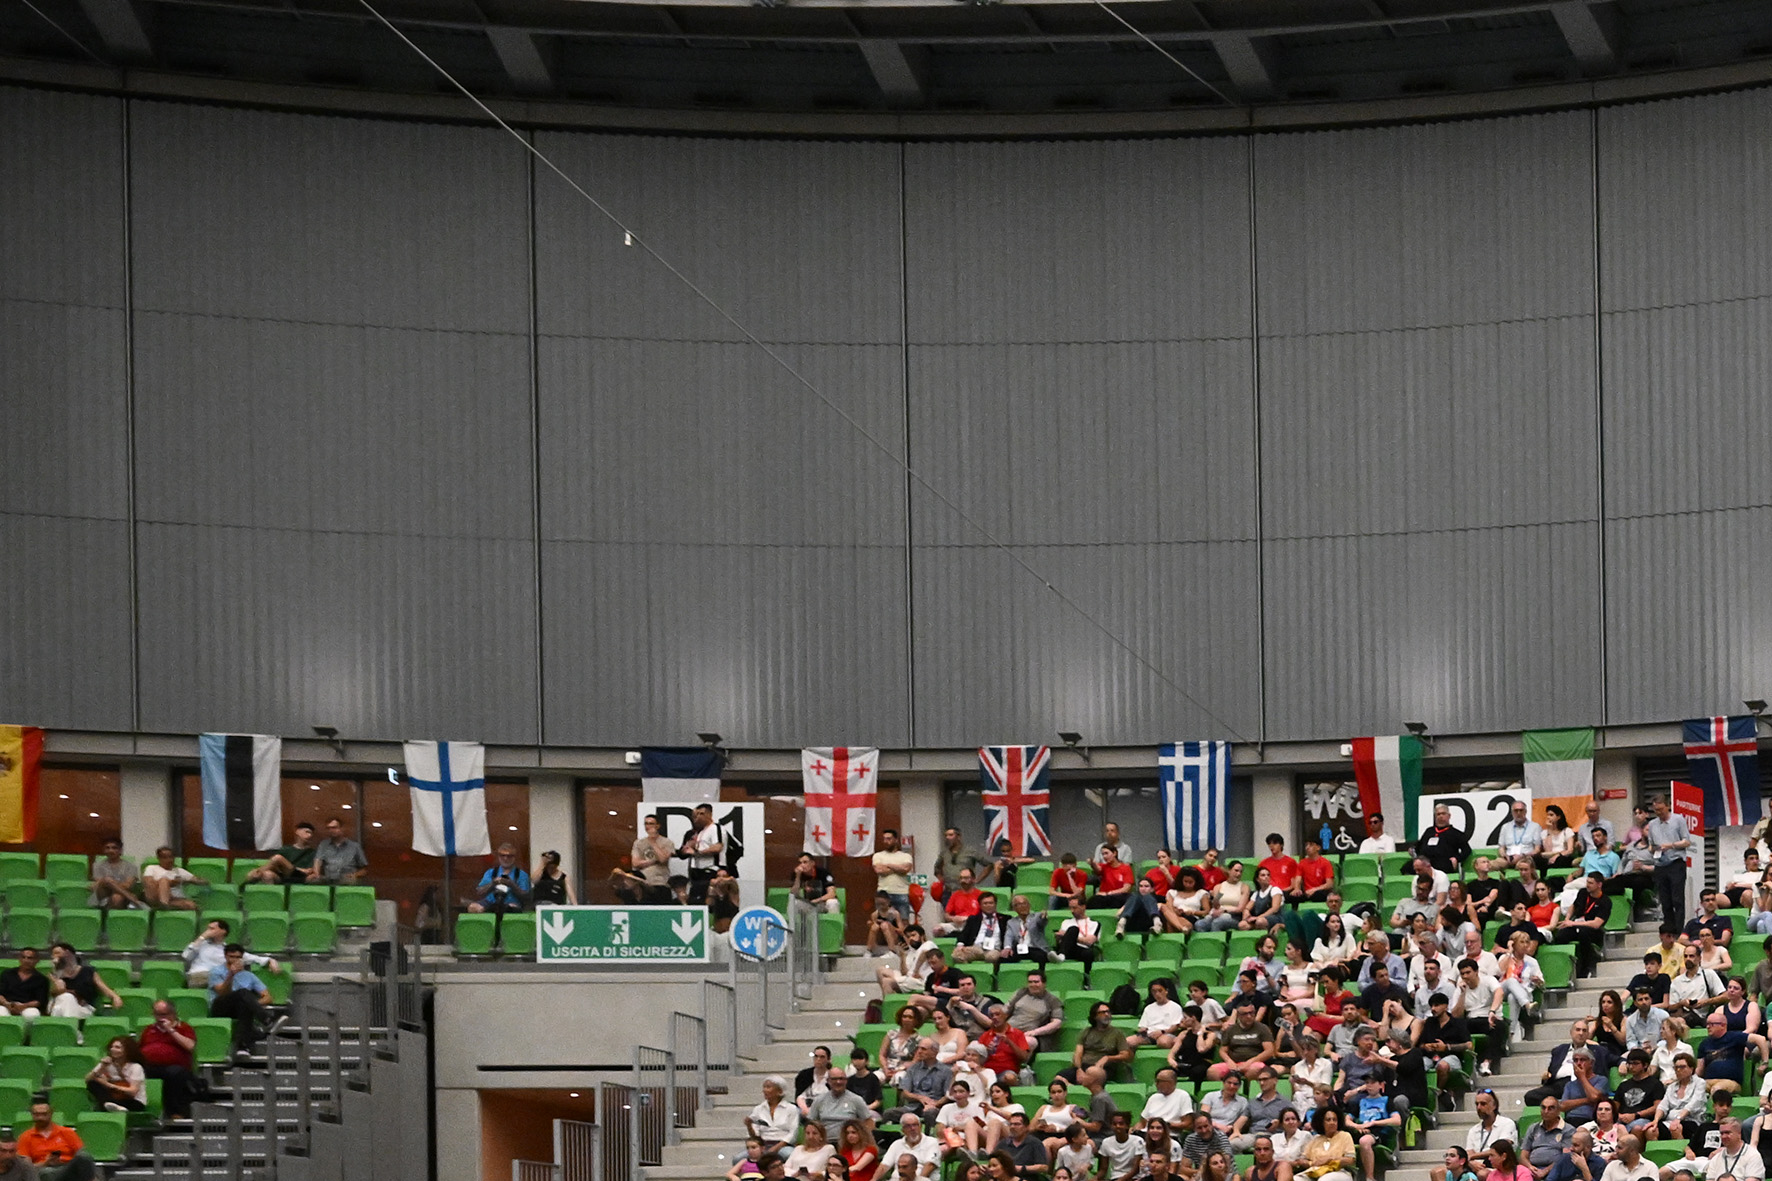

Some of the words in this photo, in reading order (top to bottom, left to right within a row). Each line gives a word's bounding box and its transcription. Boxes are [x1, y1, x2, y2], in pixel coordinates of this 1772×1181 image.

[551, 945, 600, 958] USCITA
[603, 945, 617, 958] DI
[620, 945, 696, 958] SICUREZZA
